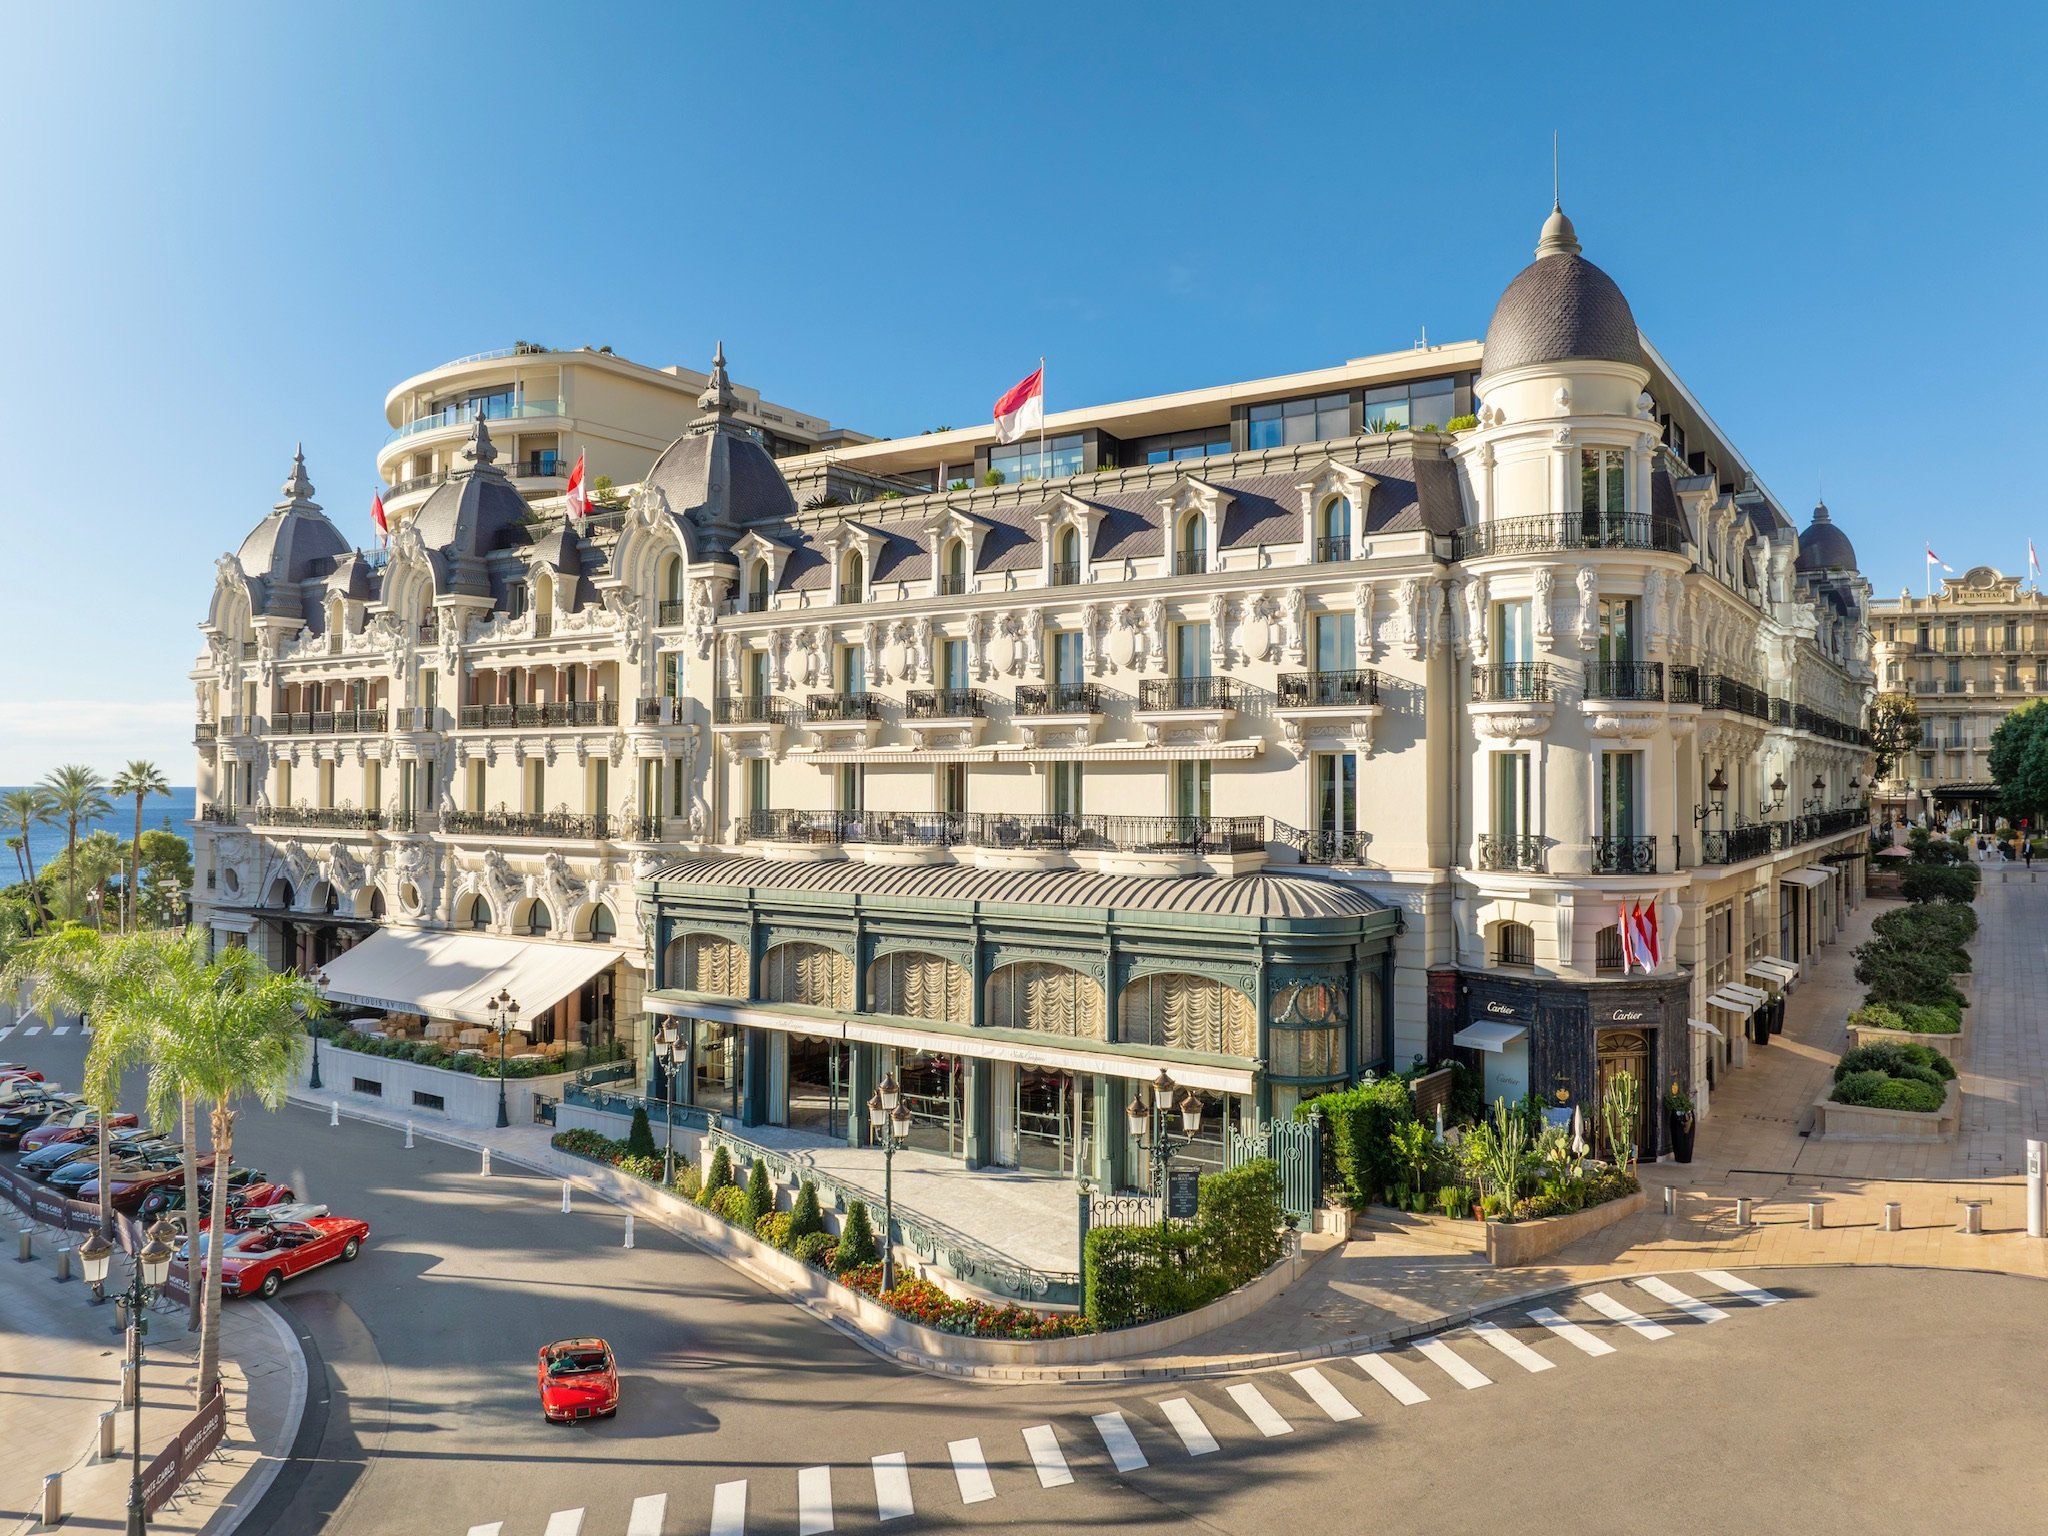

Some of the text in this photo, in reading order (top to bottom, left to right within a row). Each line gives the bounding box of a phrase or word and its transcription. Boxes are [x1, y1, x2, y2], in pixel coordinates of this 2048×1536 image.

[350, 994, 358, 1003] LE
[361, 996, 382, 1006] LOUIS
[386, 1001, 395, 1009] XV
[1487, 1001, 1515, 1015] Cartier
[1612, 1009, 1643, 1021] Cartier
[1496, 1073, 1520, 1086] Cartier
[71, 1211, 102, 1221] MONTE-CAR
[185, 1414, 219, 1455] MONTE-CARLO
[141, 1460, 175, 1499] ONTE-CARLO
